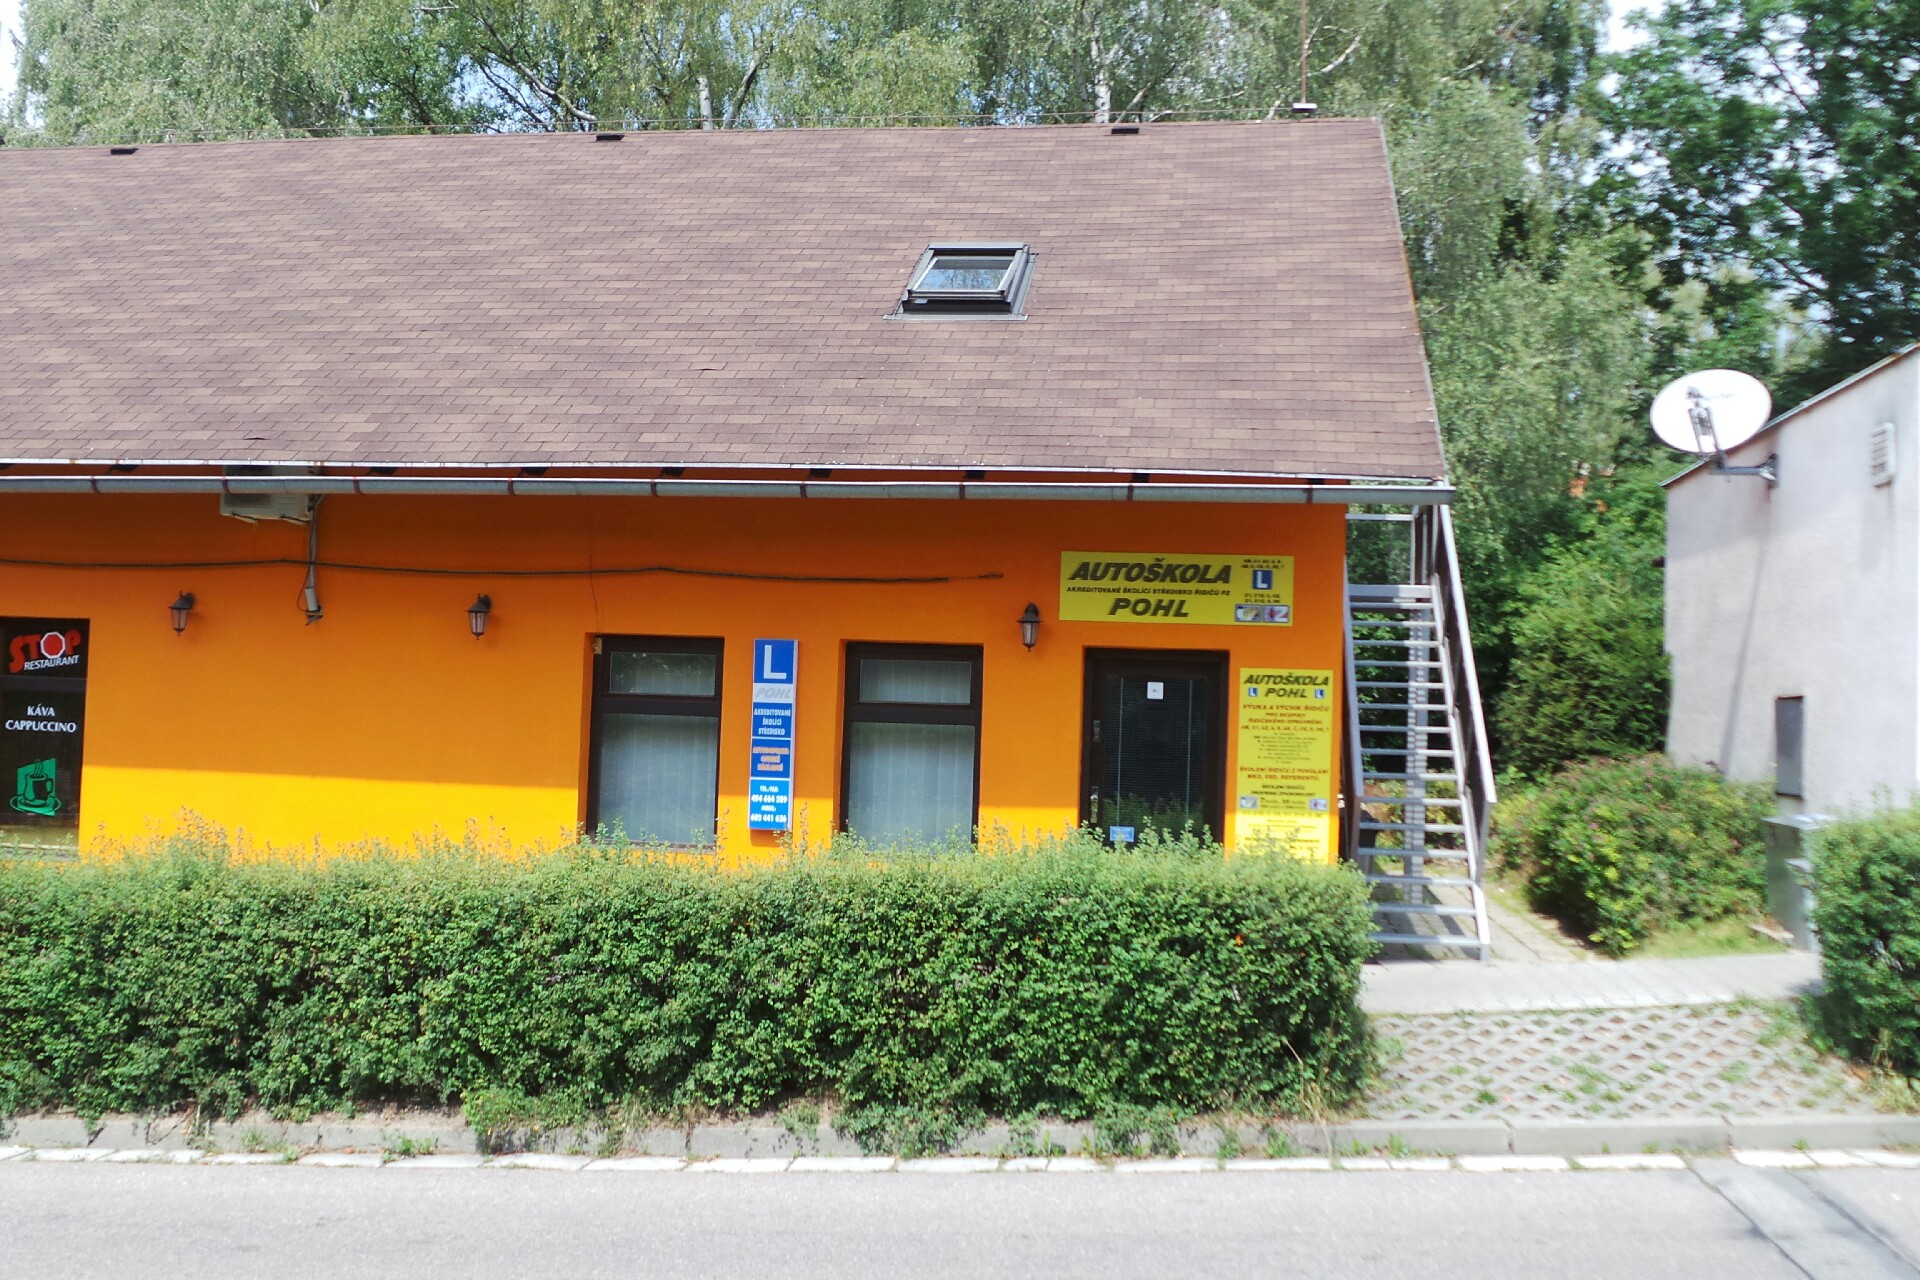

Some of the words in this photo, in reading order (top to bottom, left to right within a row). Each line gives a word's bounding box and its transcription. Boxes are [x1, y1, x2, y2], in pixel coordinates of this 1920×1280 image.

[1069, 558, 1231, 584] AUTOŠKOLA
[1257, 571, 1268, 588] L
[1066, 586, 1121, 594] AKREDITOVANÉ
[1123, 586, 1150, 594] ŠKOLÍCÍ
[1108, 597, 1189, 617] POHL
[10, 630, 82, 673] STOP
[24, 655, 79, 671] RESTAURANT
[763, 645, 787, 679] L
[1244, 672, 1329, 686] AUTOŠKOLA
[756, 687, 792, 698] POHL
[1264, 688, 1308, 698] POHL
[27, 704, 56, 717] KÁVA
[754, 707, 792, 716] AKREDITOVANÉ
[5, 720, 77, 733] CAPPUCCINO
[758, 726, 786, 736] STŘEDISKO
